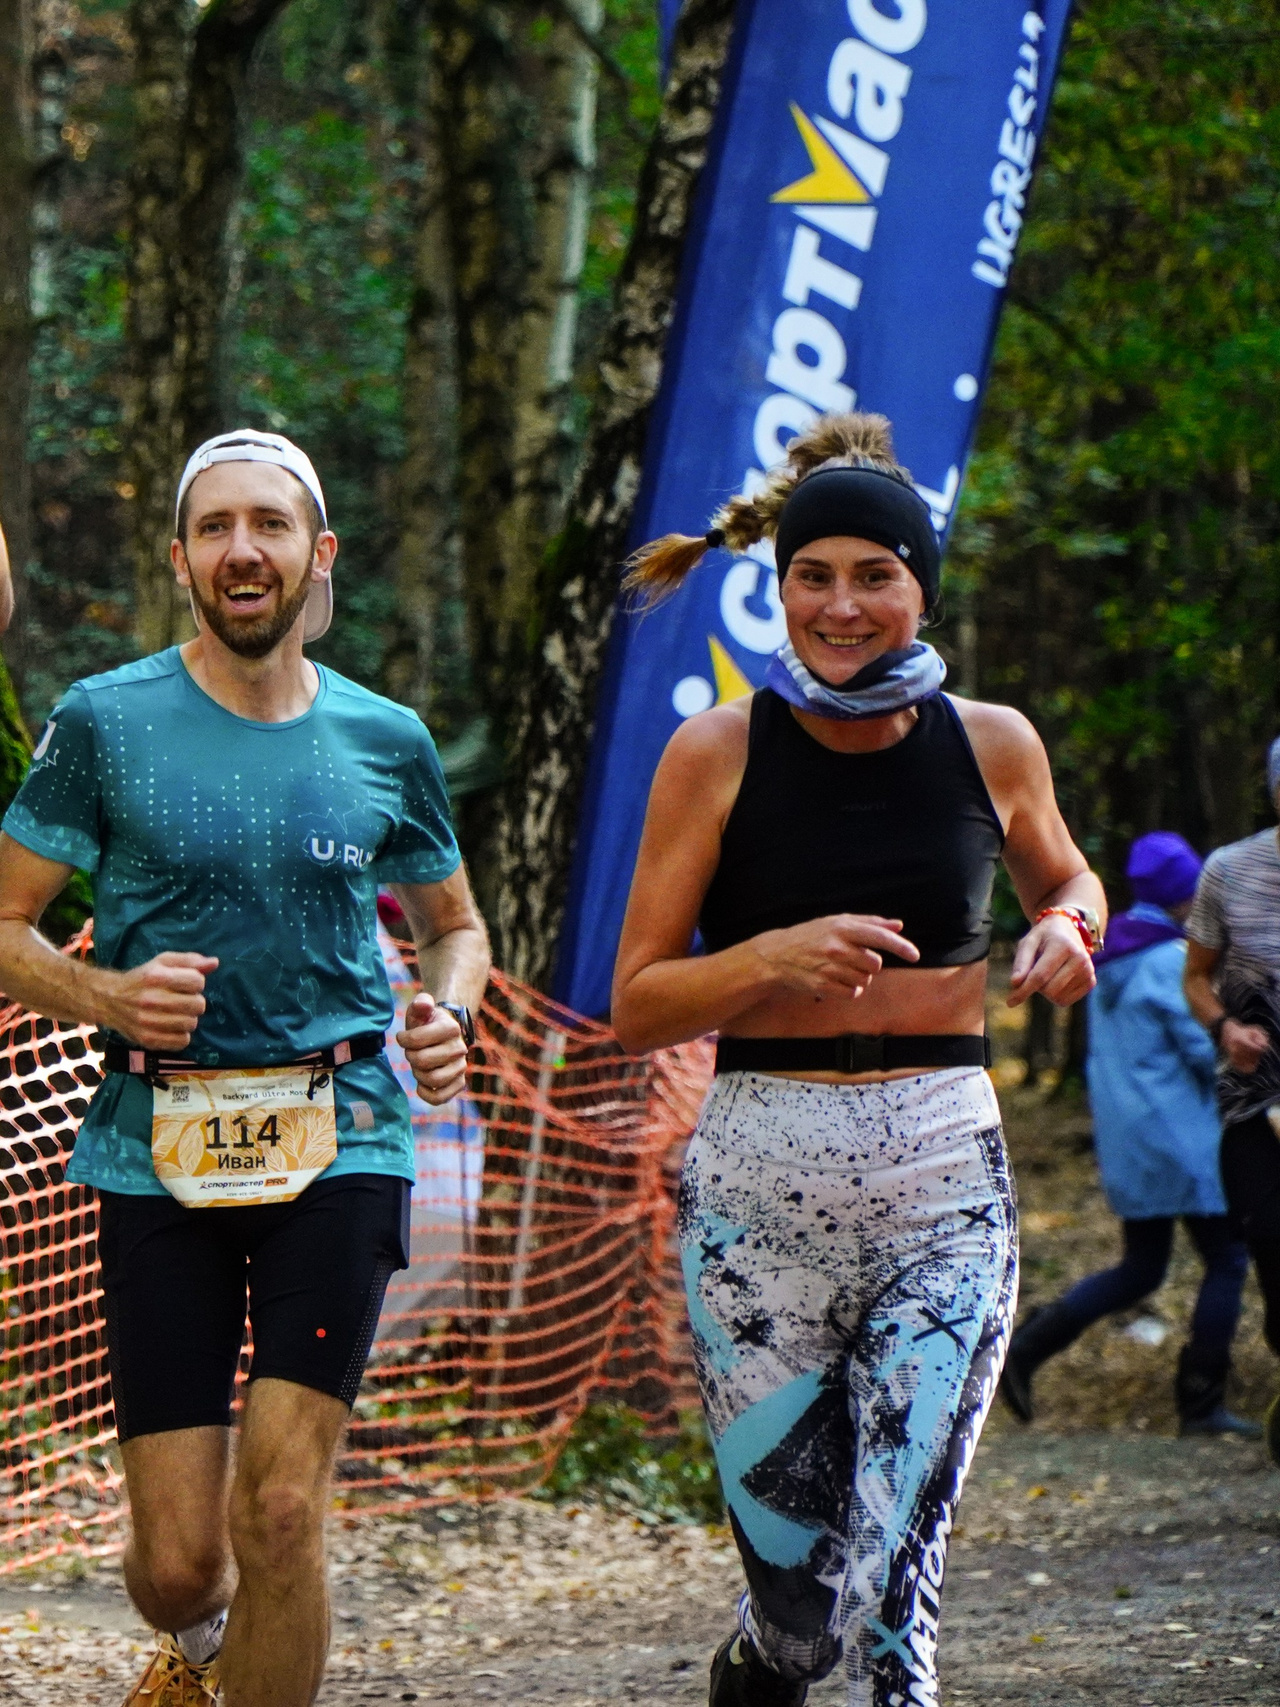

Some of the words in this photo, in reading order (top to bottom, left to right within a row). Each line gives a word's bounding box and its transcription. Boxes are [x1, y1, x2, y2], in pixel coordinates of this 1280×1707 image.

[222, 1092, 258, 1102] Backyard
[262, 1091, 286, 1099] Ultra
[289, 1089, 318, 1098] Moscw
[205, 1114, 281, 1149] 114
[218, 1152, 266, 1170] Иван
[265, 1177, 288, 1186] PRO
